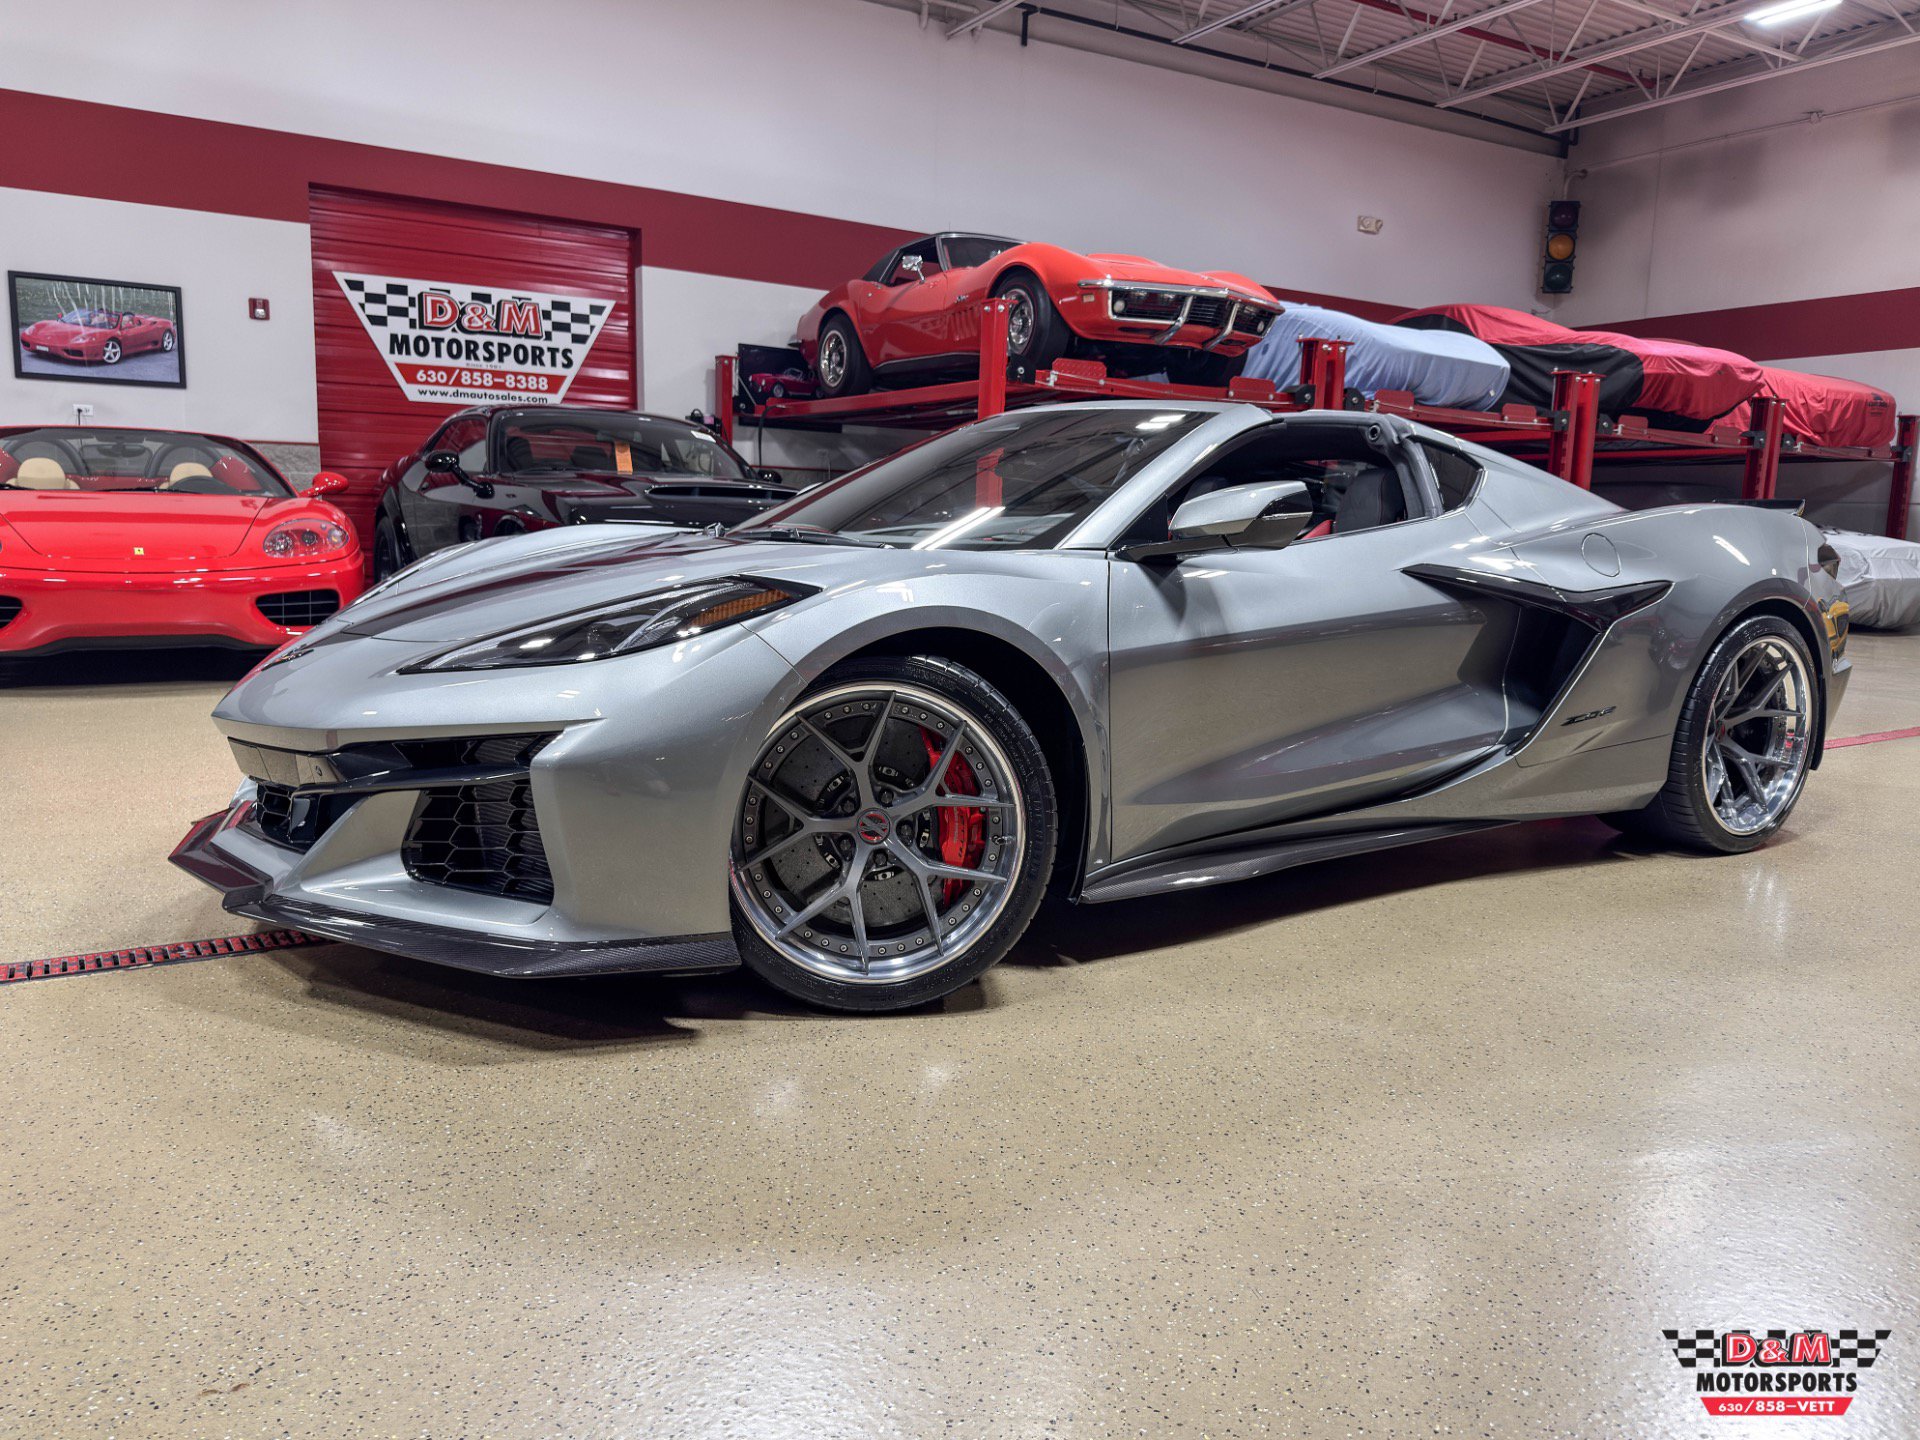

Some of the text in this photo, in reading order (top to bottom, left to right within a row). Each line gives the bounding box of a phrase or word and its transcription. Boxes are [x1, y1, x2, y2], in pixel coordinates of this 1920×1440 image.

[418, 291, 544, 340] D&M
[389, 333, 574, 369] MOTORSPORTS
[416, 369, 549, 390] 630/858-8388
[418, 388, 548, 404] www.dmautosales.com
